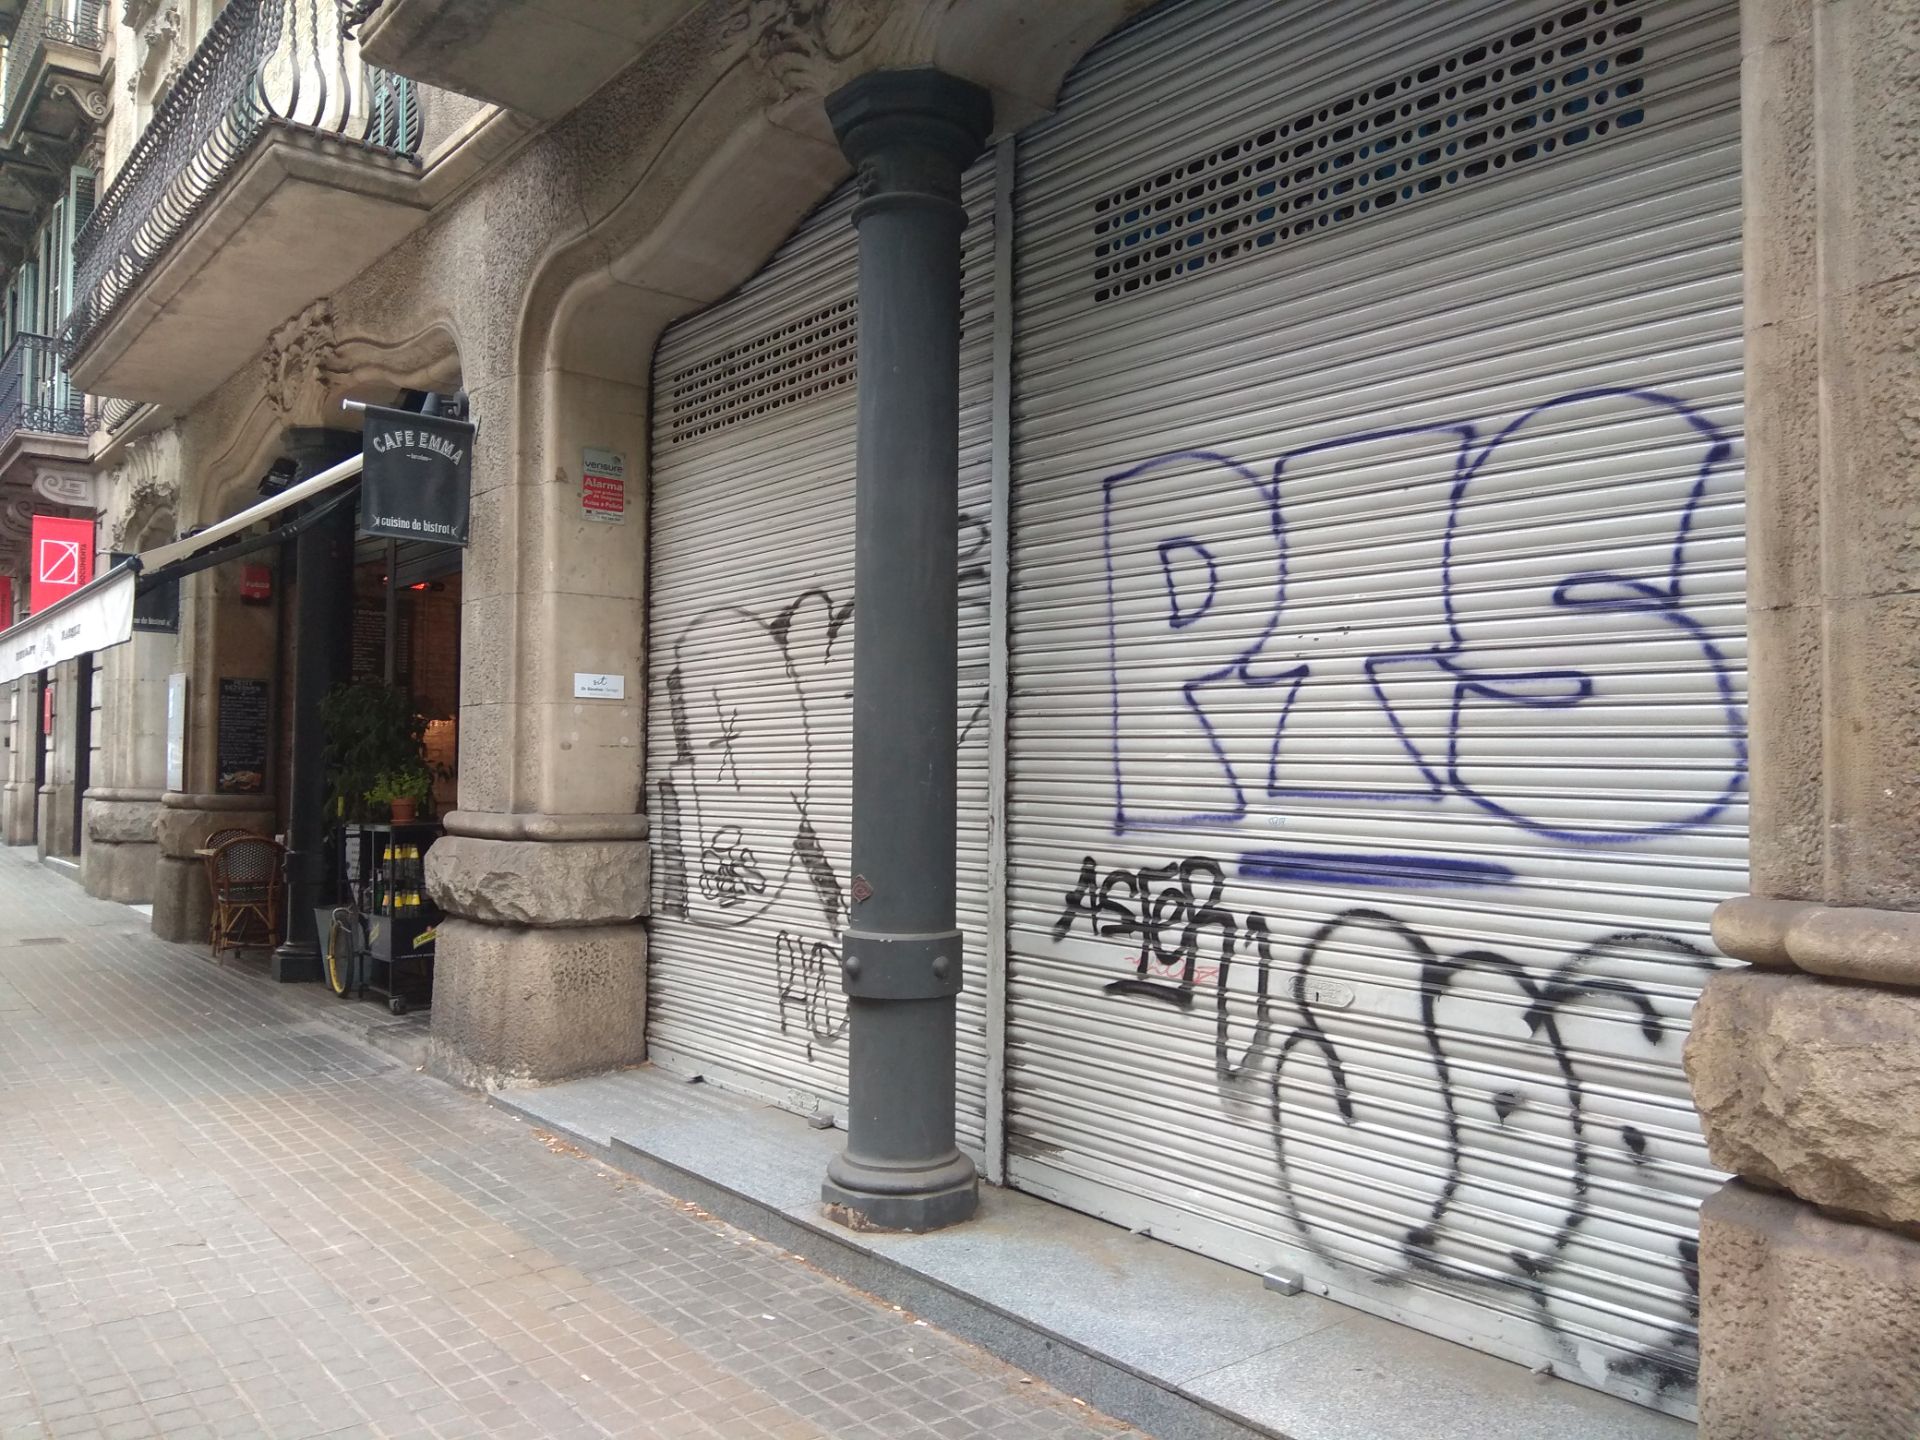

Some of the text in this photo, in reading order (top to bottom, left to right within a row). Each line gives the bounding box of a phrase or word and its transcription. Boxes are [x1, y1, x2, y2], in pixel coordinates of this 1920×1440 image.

[373, 430, 464, 466] CAFE EMMA
[584, 477, 623, 491] Alarma
[381, 516, 450, 534] cuisine de bistrot
